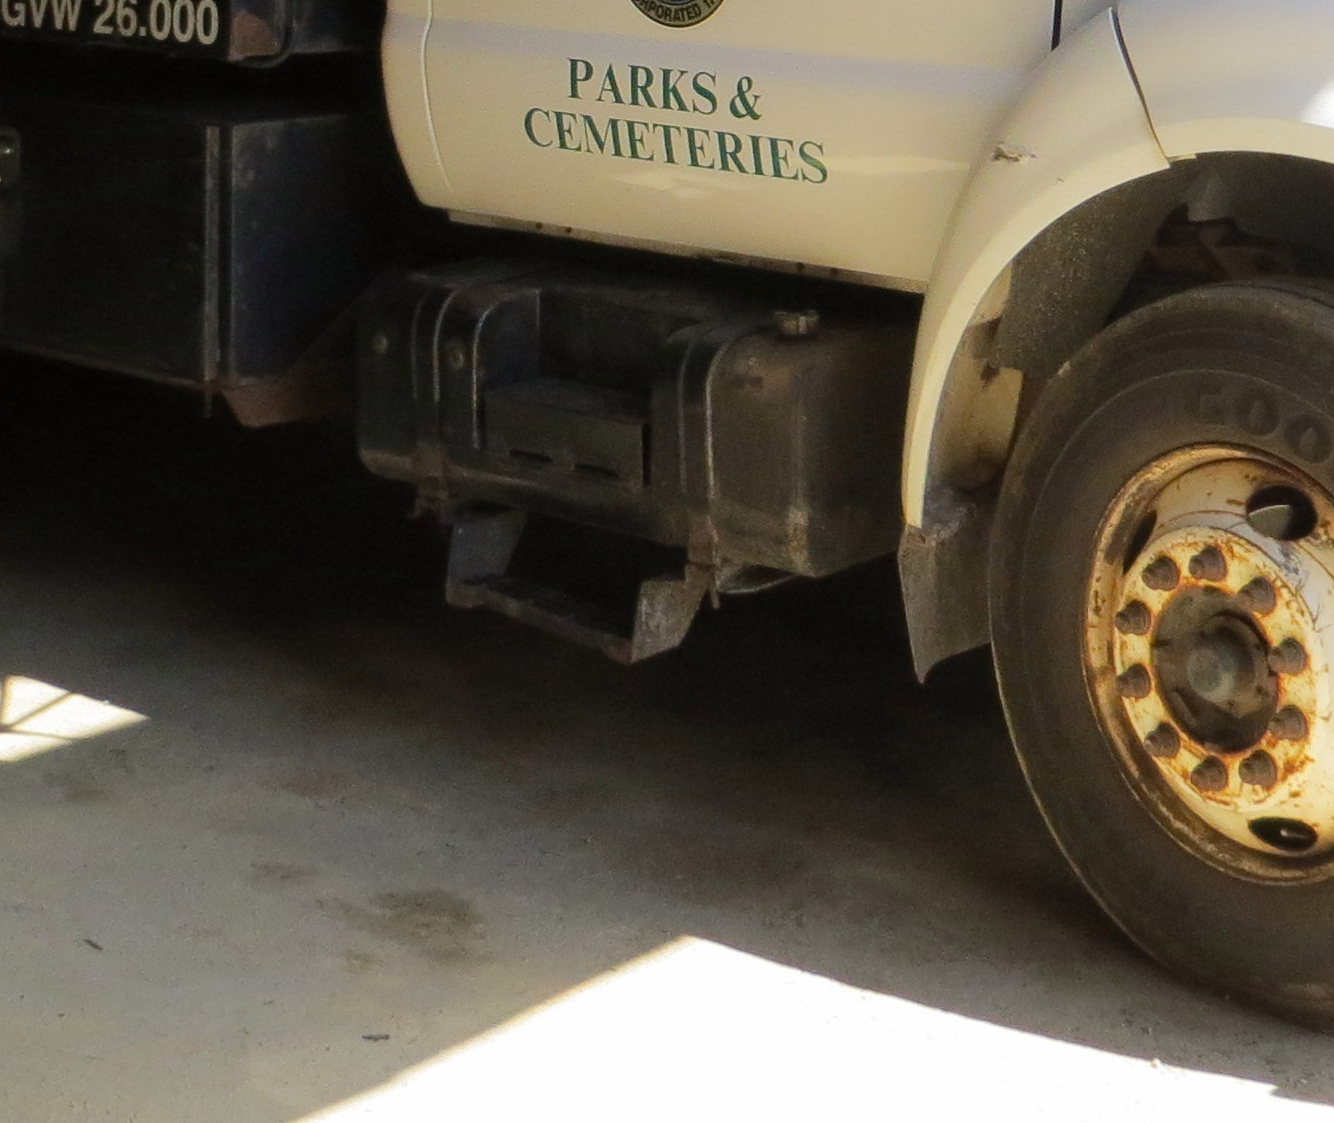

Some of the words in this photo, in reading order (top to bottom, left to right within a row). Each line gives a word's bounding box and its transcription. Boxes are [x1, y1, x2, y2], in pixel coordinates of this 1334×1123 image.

[567, 57, 718, 116] PARKS
[729, 75, 763, 121] &
[523, 107, 829, 185] CEMETERIES
